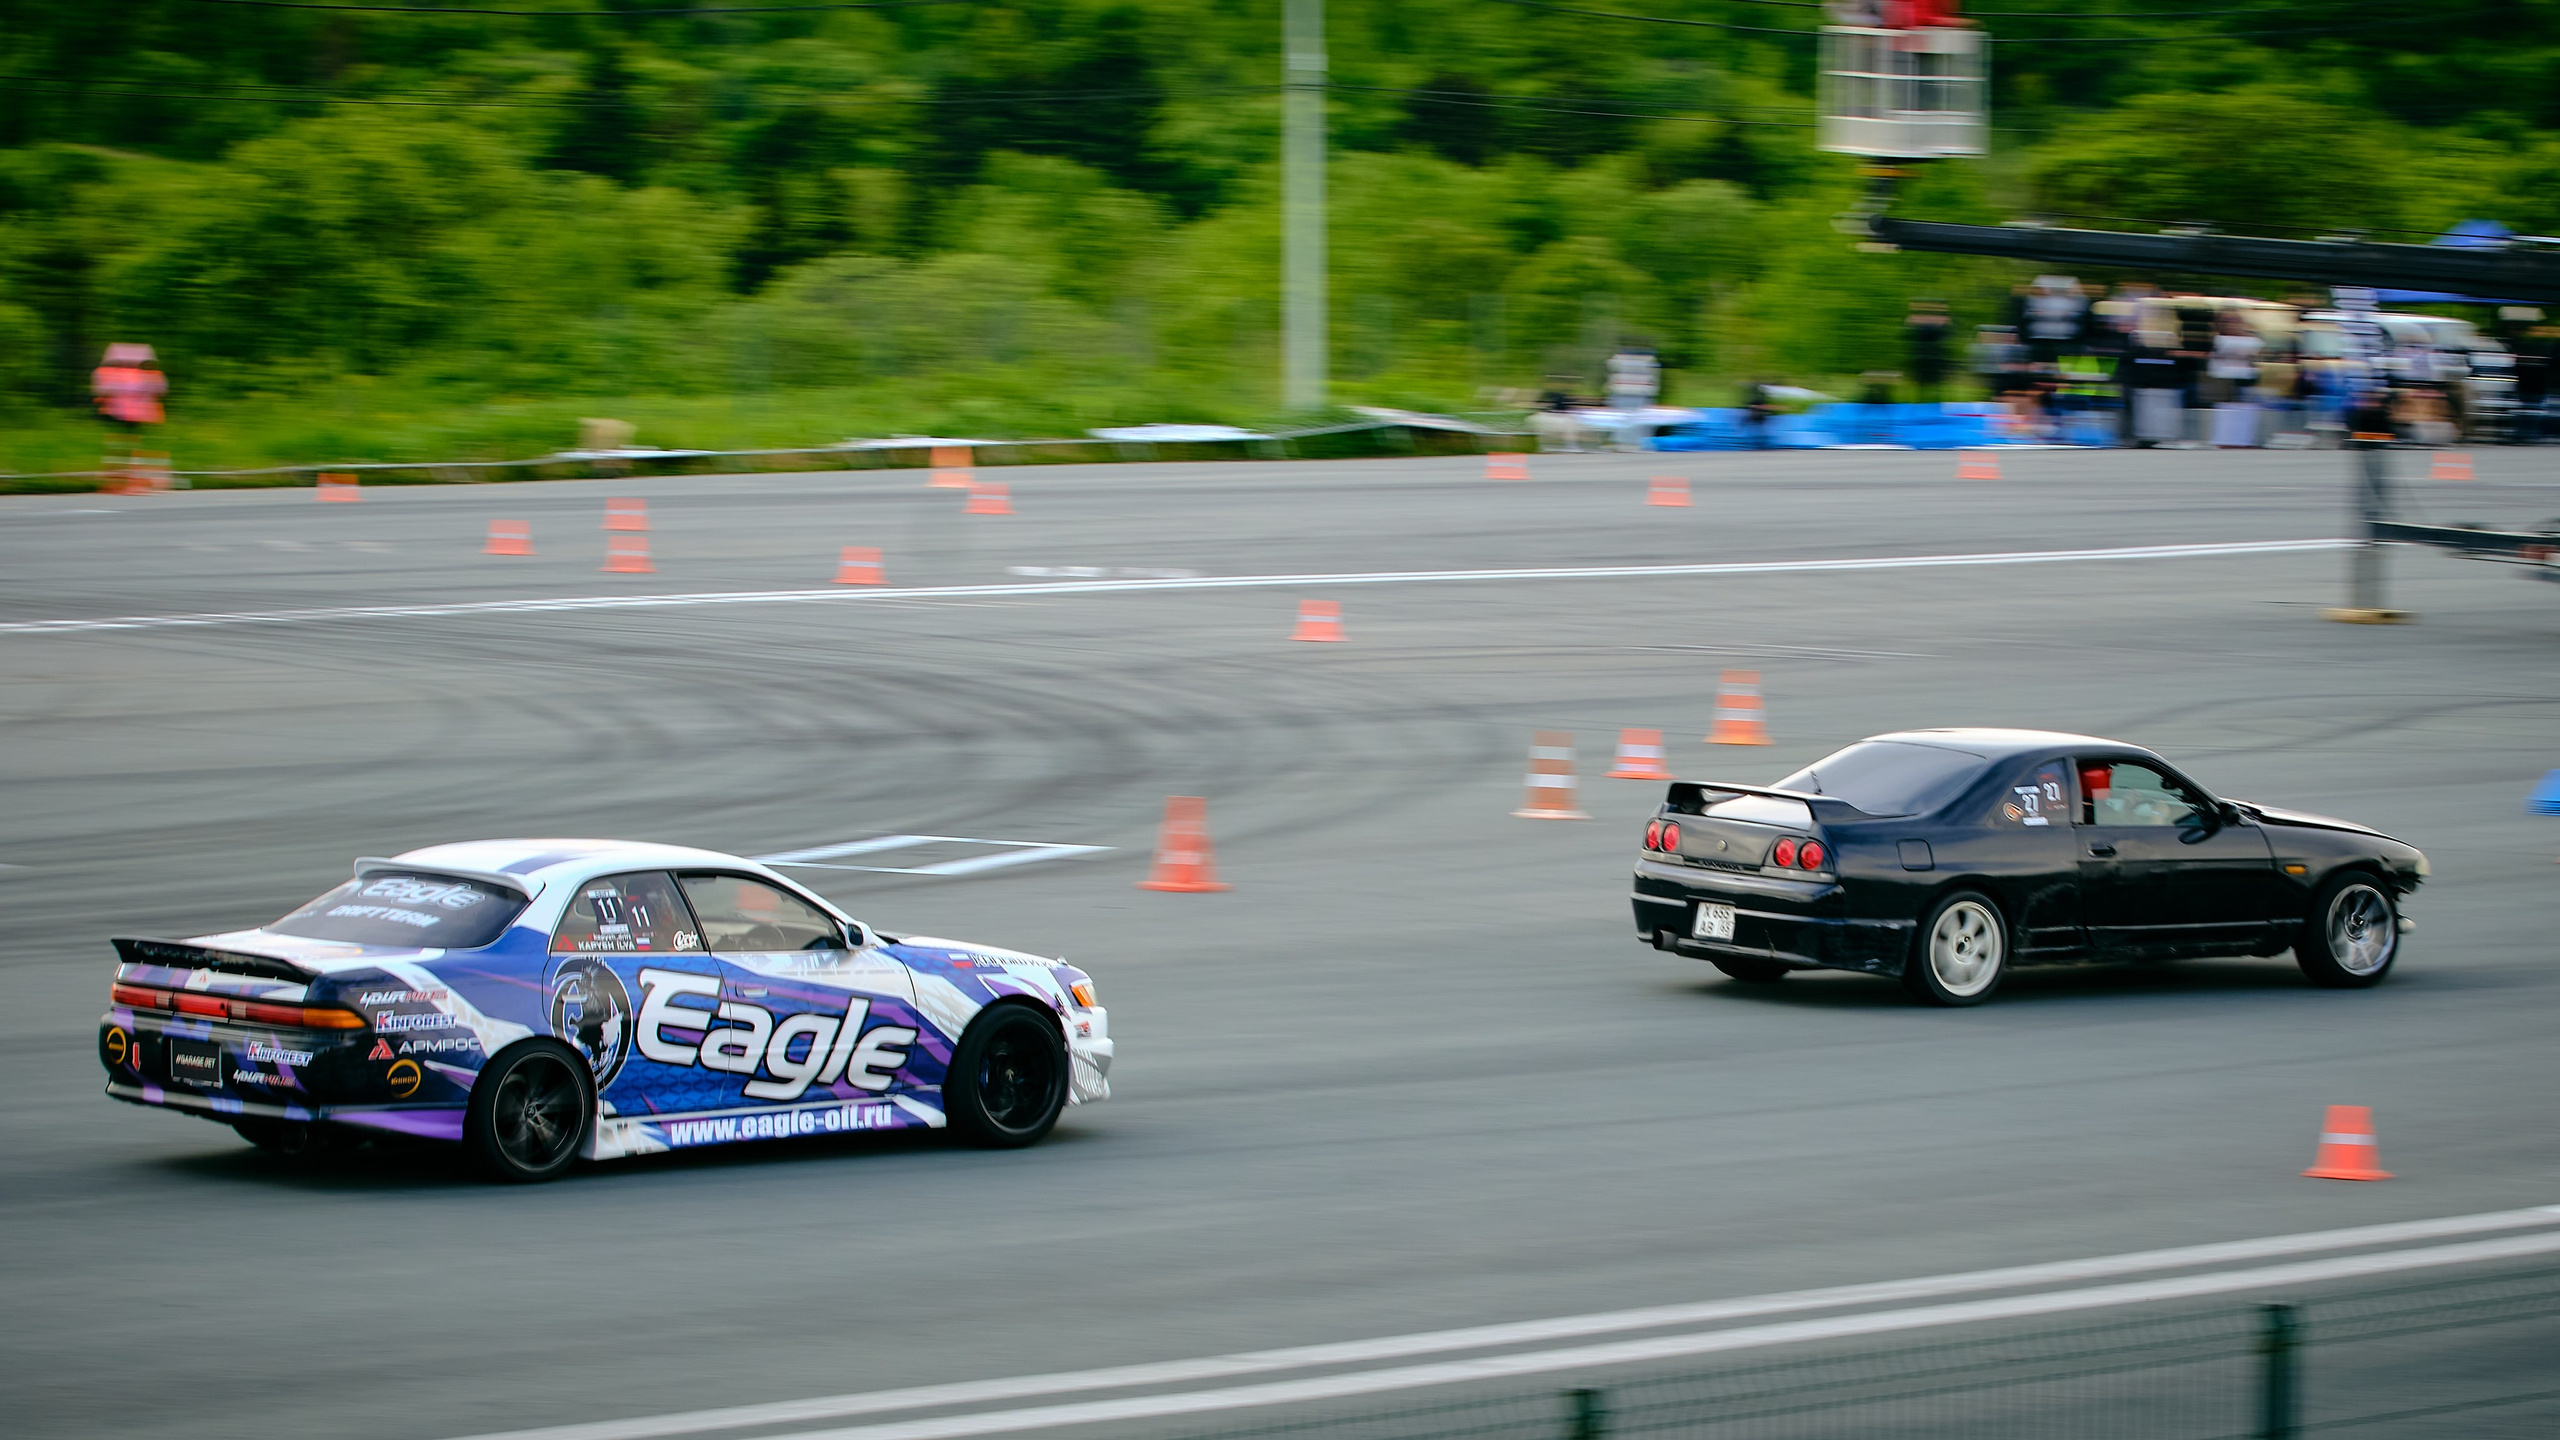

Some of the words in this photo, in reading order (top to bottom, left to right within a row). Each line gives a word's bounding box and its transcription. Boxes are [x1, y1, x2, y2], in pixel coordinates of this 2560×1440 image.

[2043, 782, 2061, 802] 27
[2022, 793, 2039, 815] 27
[358, 876, 486, 910] Eagle
[598, 898, 617, 920] 11
[632, 905, 650, 928] 11
[637, 966, 919, 1101] Eagle
[671, 1103, 893, 1146] www.eagle-oil.ru
